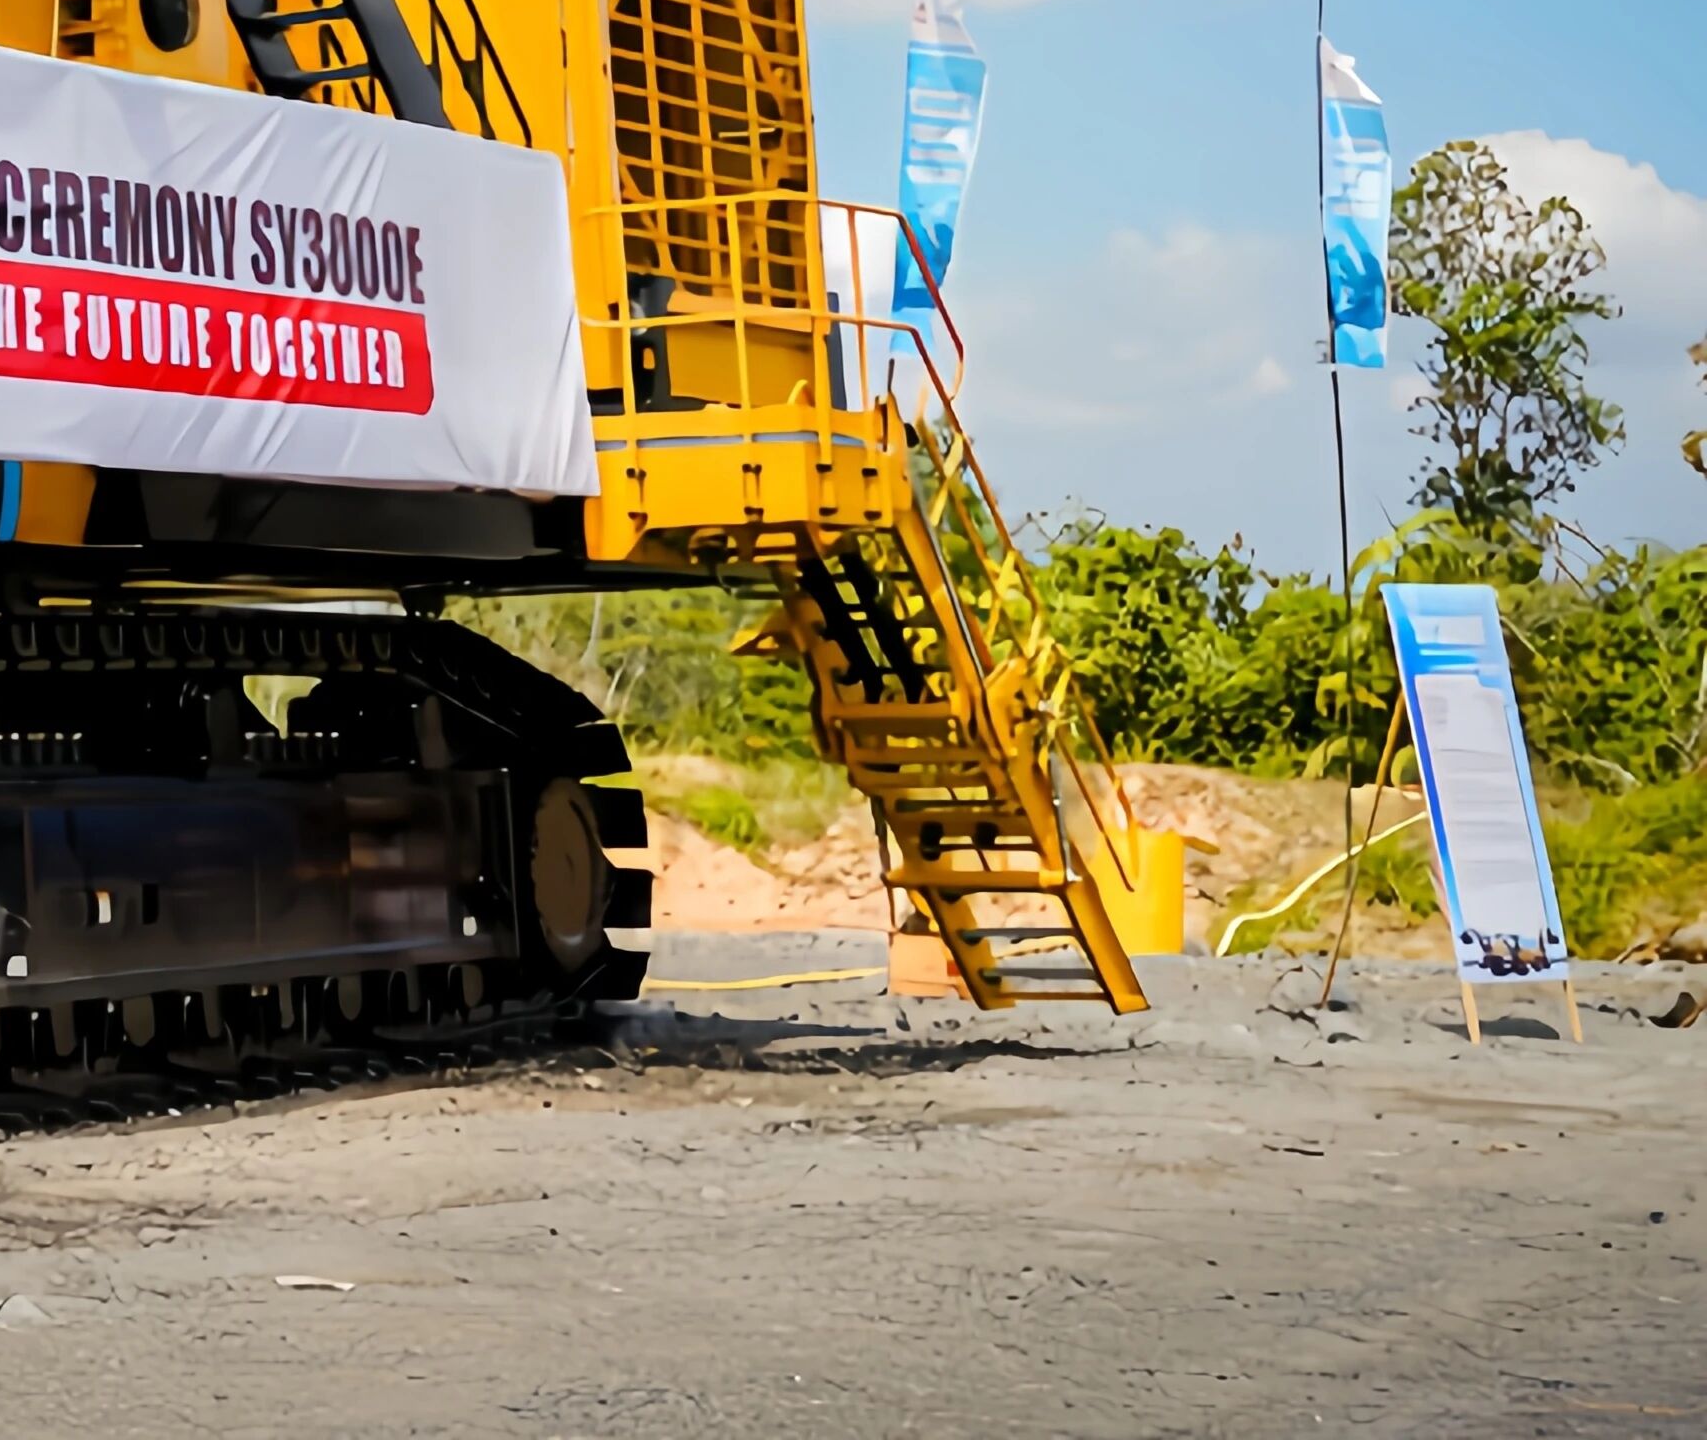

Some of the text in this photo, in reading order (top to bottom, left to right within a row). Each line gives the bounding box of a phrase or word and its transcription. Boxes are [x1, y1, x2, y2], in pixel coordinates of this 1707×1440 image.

[249, 199, 425, 304] SY3000E
[62, 291, 212, 369] FUTURE
[226, 311, 405, 388] TOGETHER
